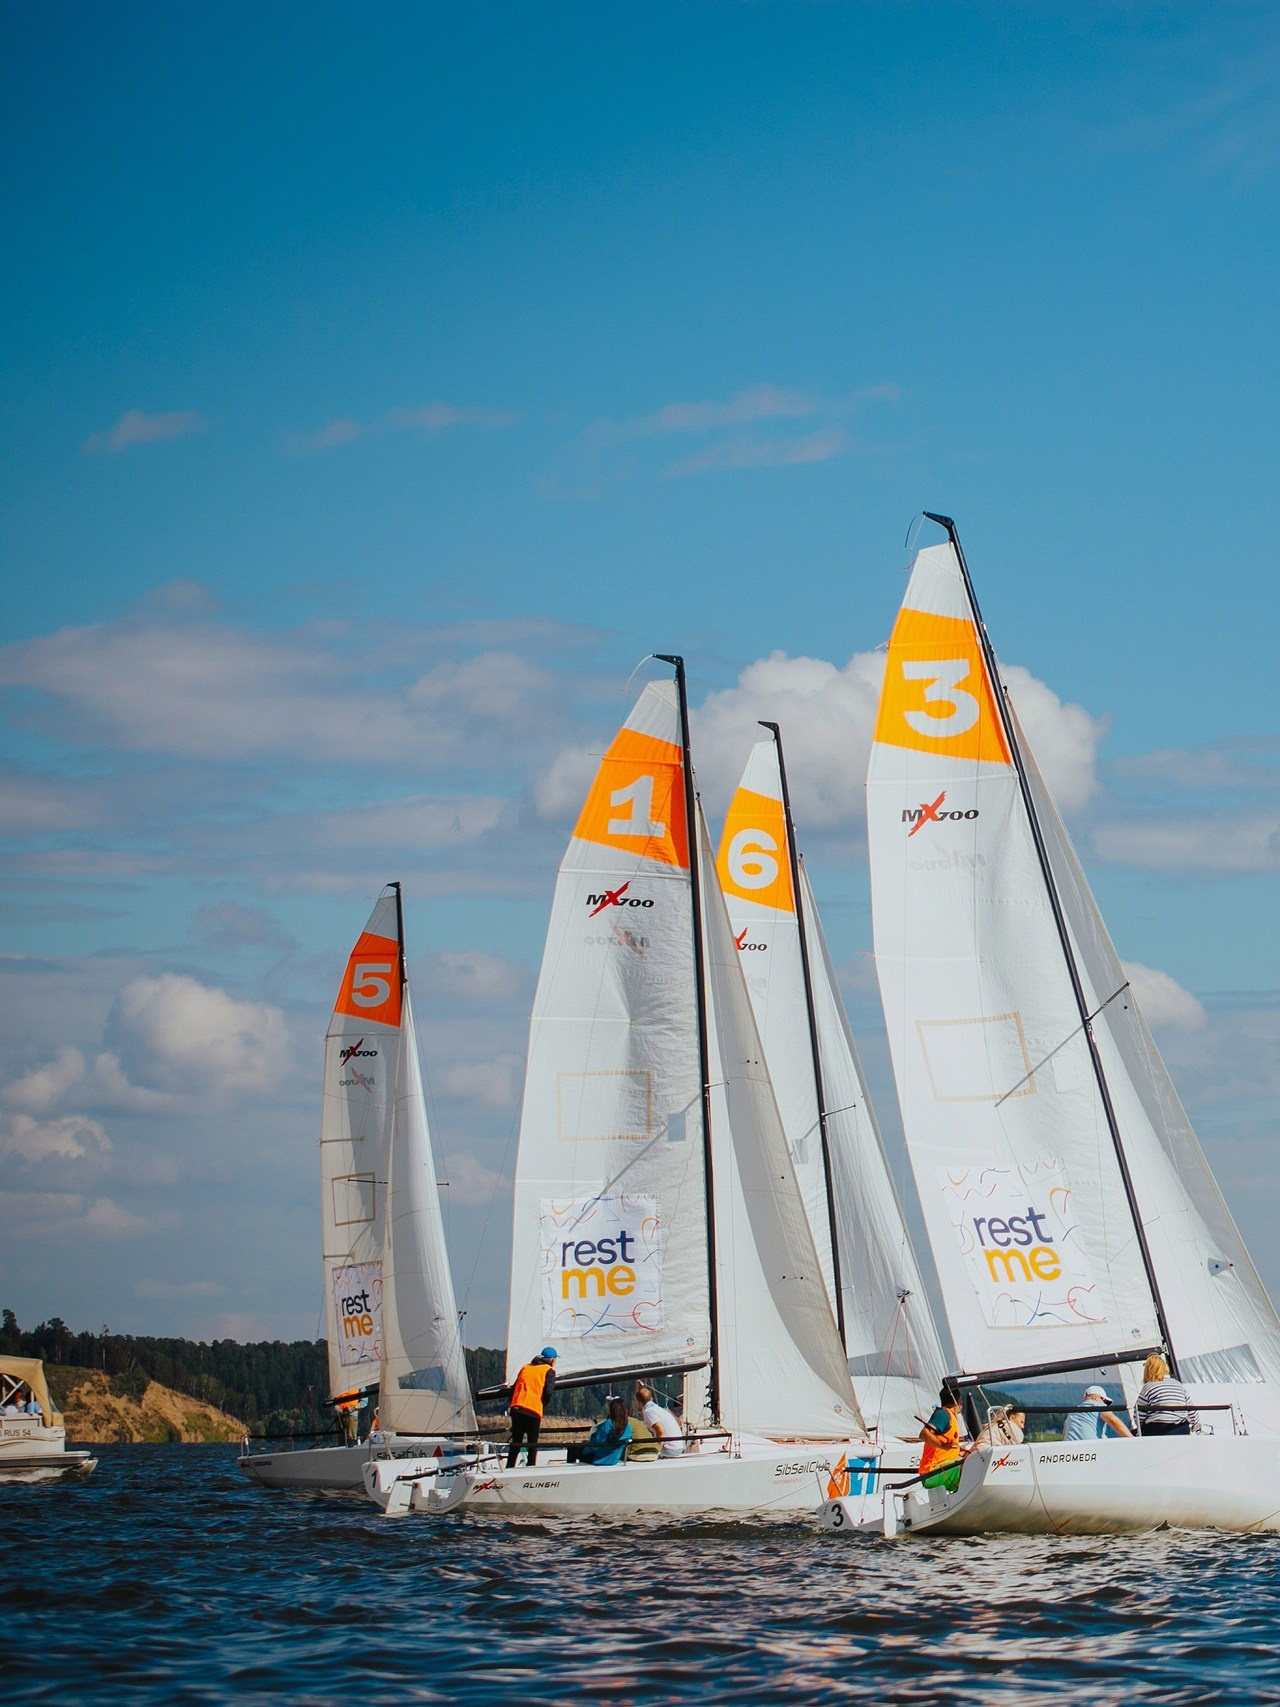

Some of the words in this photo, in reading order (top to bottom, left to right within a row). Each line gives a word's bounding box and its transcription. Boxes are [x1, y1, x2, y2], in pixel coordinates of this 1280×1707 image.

[902, 658, 980, 738] 3
[607, 775, 666, 838] 1
[727, 828, 779, 890] 6
[351, 963, 392, 1008] 5
[972, 1206, 1054, 1247] rest
[561, 1230, 636, 1268] rest
[983, 1246, 1062, 1283] me
[561, 1265, 636, 1299] me
[341, 1289, 371, 1316] rest
[343, 1314, 373, 1339] me
[1039, 1453, 1097, 1464] ANDROMEDA
[370, 1470, 378, 1489] 1
[522, 1481, 560, 1489] ALINGHI
[857, 1461, 871, 1497] 1
[831, 1503, 845, 1528] 3
